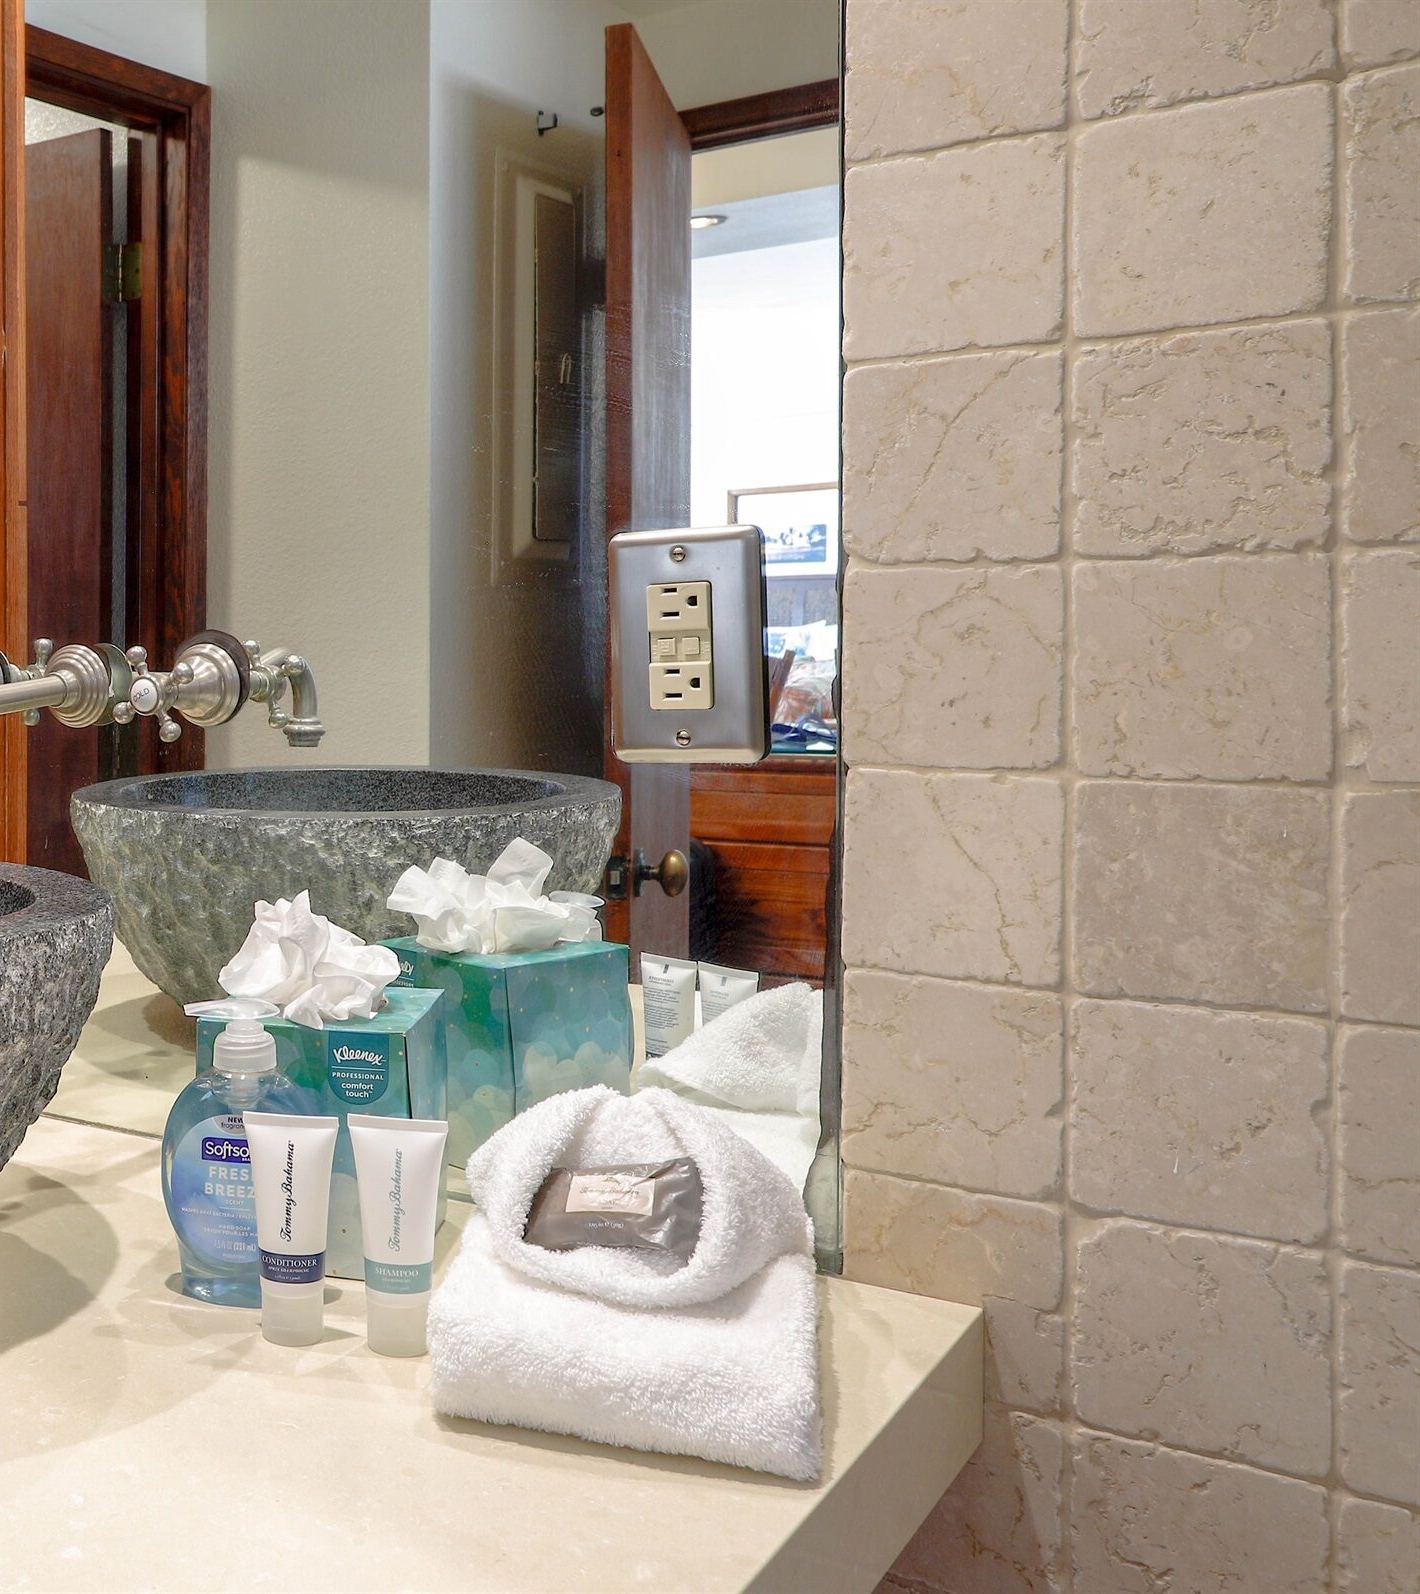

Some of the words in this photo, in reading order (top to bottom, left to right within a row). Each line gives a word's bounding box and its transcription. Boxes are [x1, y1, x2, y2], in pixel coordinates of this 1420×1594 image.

[133, 688, 150, 702] COLD
[333, 1046, 384, 1066] Kleenex
[332, 1071, 384, 1081] PROFESSIONAL
[341, 1082, 374, 1090] comfort
[221, 1122, 245, 1130] fragran
[227, 1116, 244, 1124] NEW
[205, 1141, 250, 1160] Softso
[209, 1166, 250, 1181] FRES
[204, 1182, 256, 1199] BREEZ
[262, 1255, 318, 1268] CONDITIONER
[374, 1266, 419, 1278] SHAMPOO
